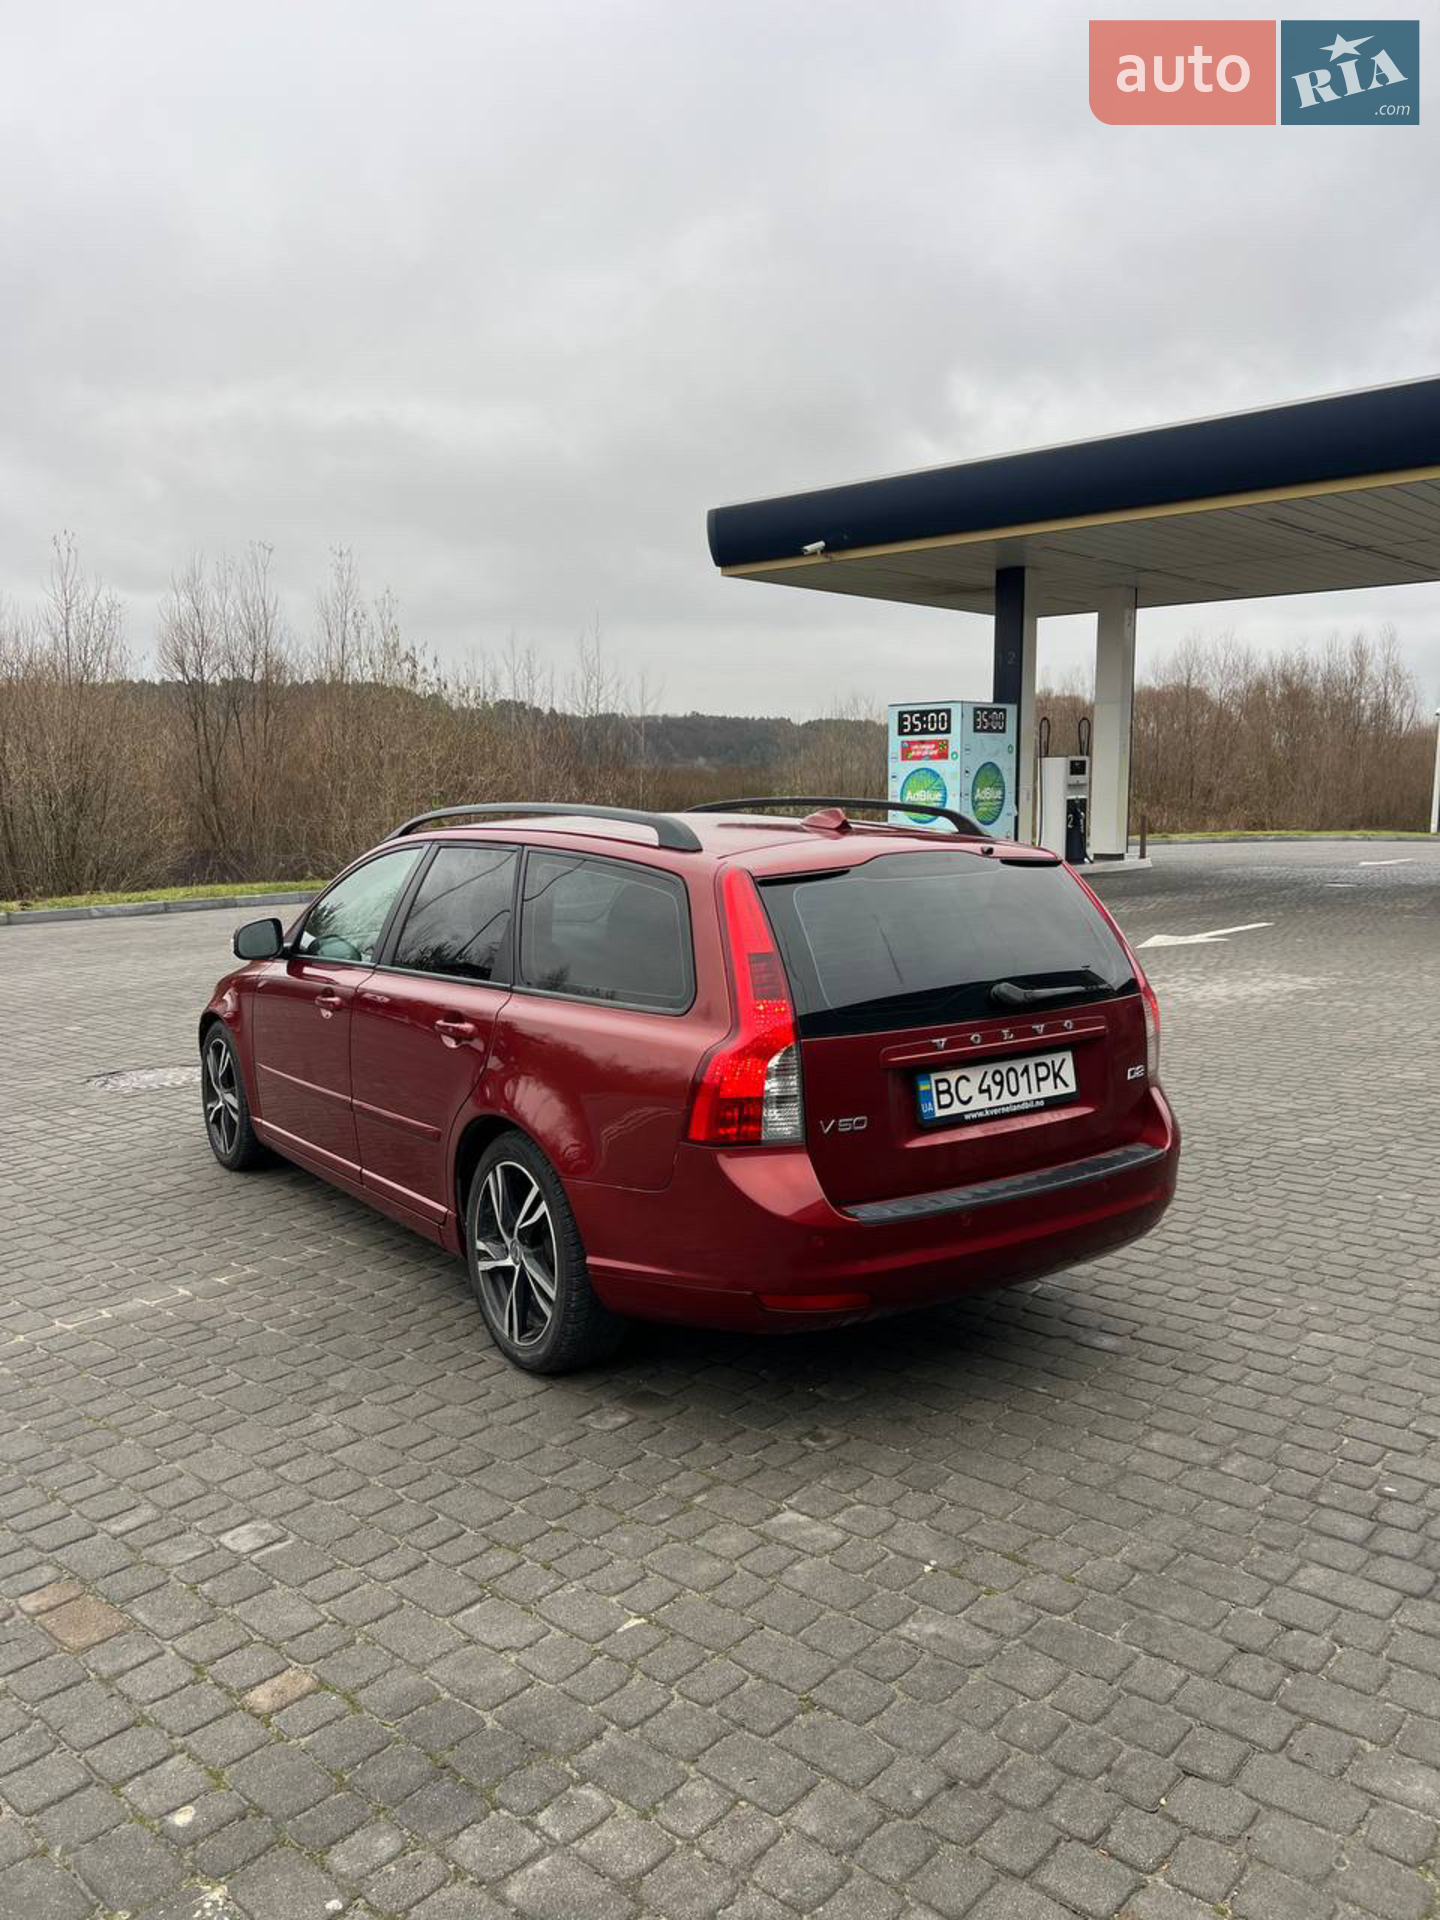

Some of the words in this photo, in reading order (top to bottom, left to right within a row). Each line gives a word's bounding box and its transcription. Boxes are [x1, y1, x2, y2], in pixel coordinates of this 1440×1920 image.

[906, 789, 943, 802] AdBlue
[974, 786, 1003, 800] AdBlue
[1067, 813, 1074, 829] 2
[931, 1019, 1074, 1050] VOLVO
[921, 1103, 934, 1113] UA
[819, 1115, 868, 1134] V50
